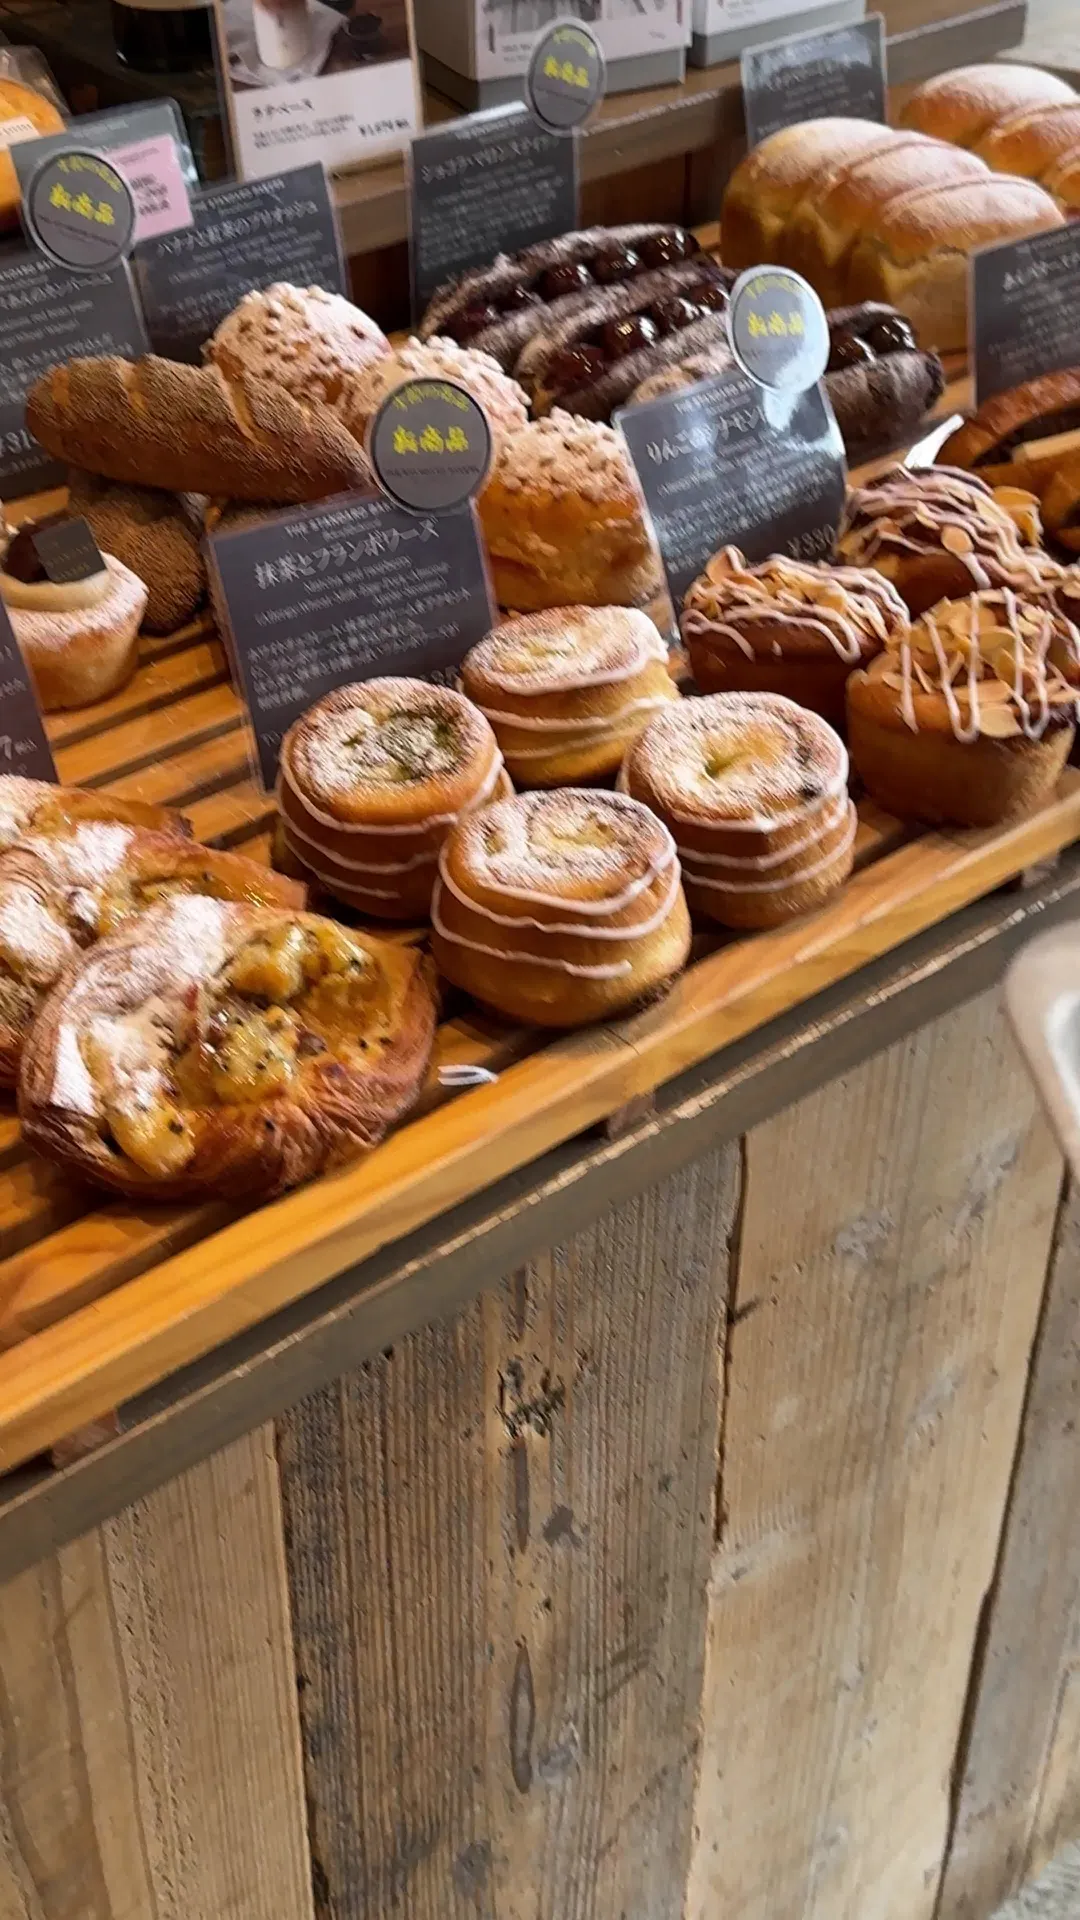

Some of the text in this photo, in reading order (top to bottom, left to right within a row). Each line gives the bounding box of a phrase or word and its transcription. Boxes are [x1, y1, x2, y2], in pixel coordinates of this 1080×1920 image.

[254, 514, 440, 590] 抹茶とフランボワーズ
